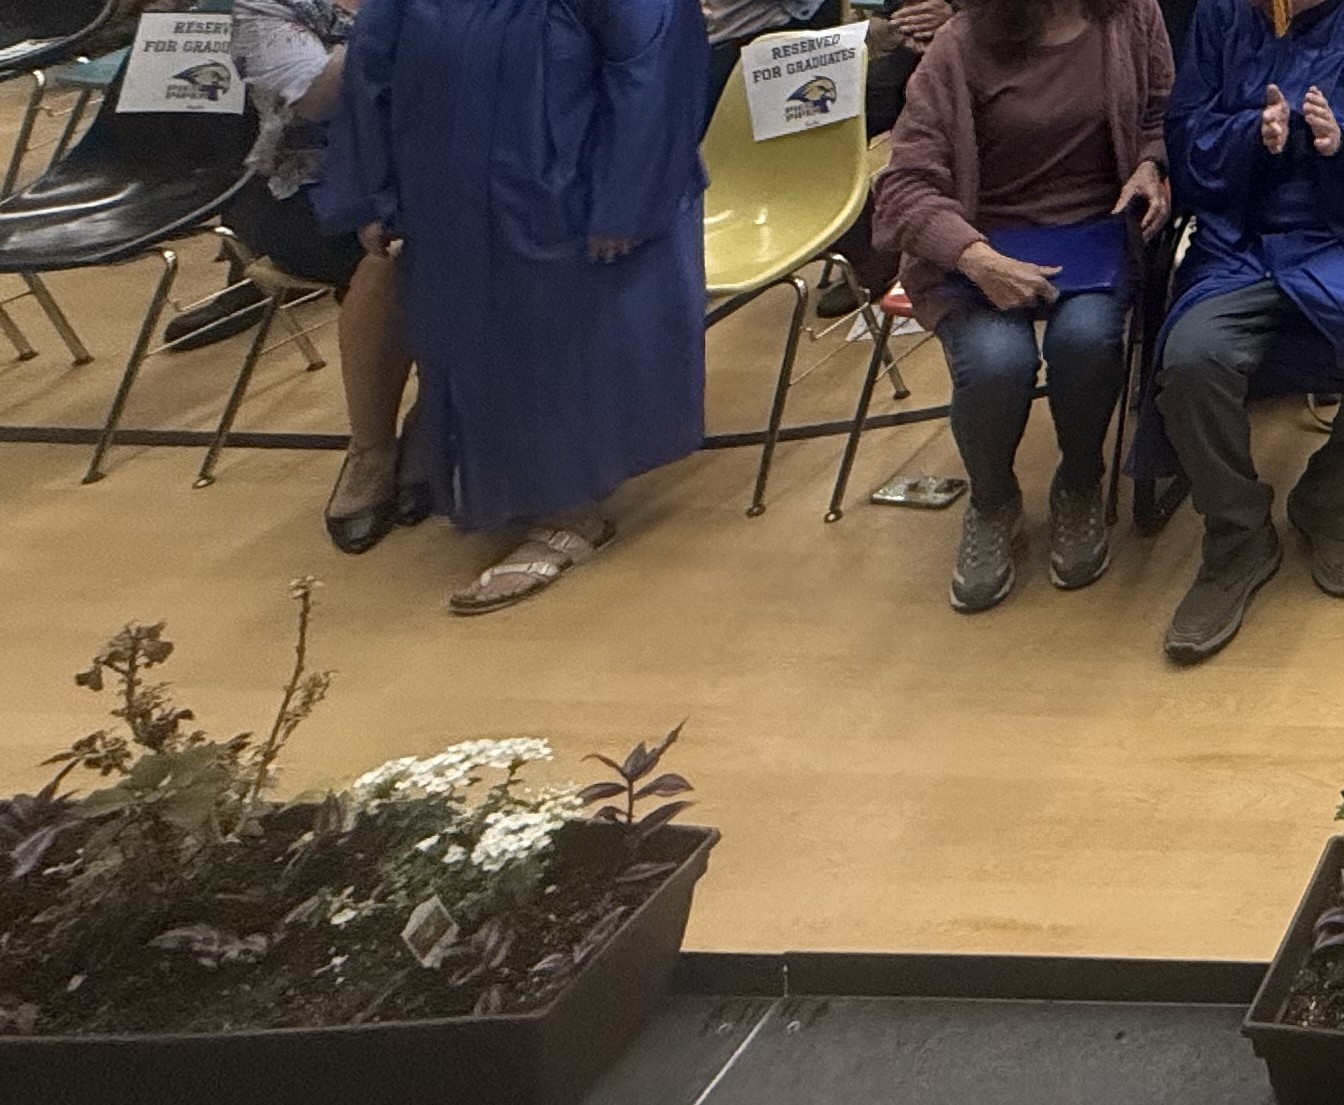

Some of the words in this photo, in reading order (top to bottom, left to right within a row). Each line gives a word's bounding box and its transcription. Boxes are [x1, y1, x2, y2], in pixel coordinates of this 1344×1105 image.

[142, 40, 178, 53] FOR
[772, 34, 841, 60] RESERVED
[752, 66, 782, 84] FOR
[786, 47, 856, 75] GRADUATES
